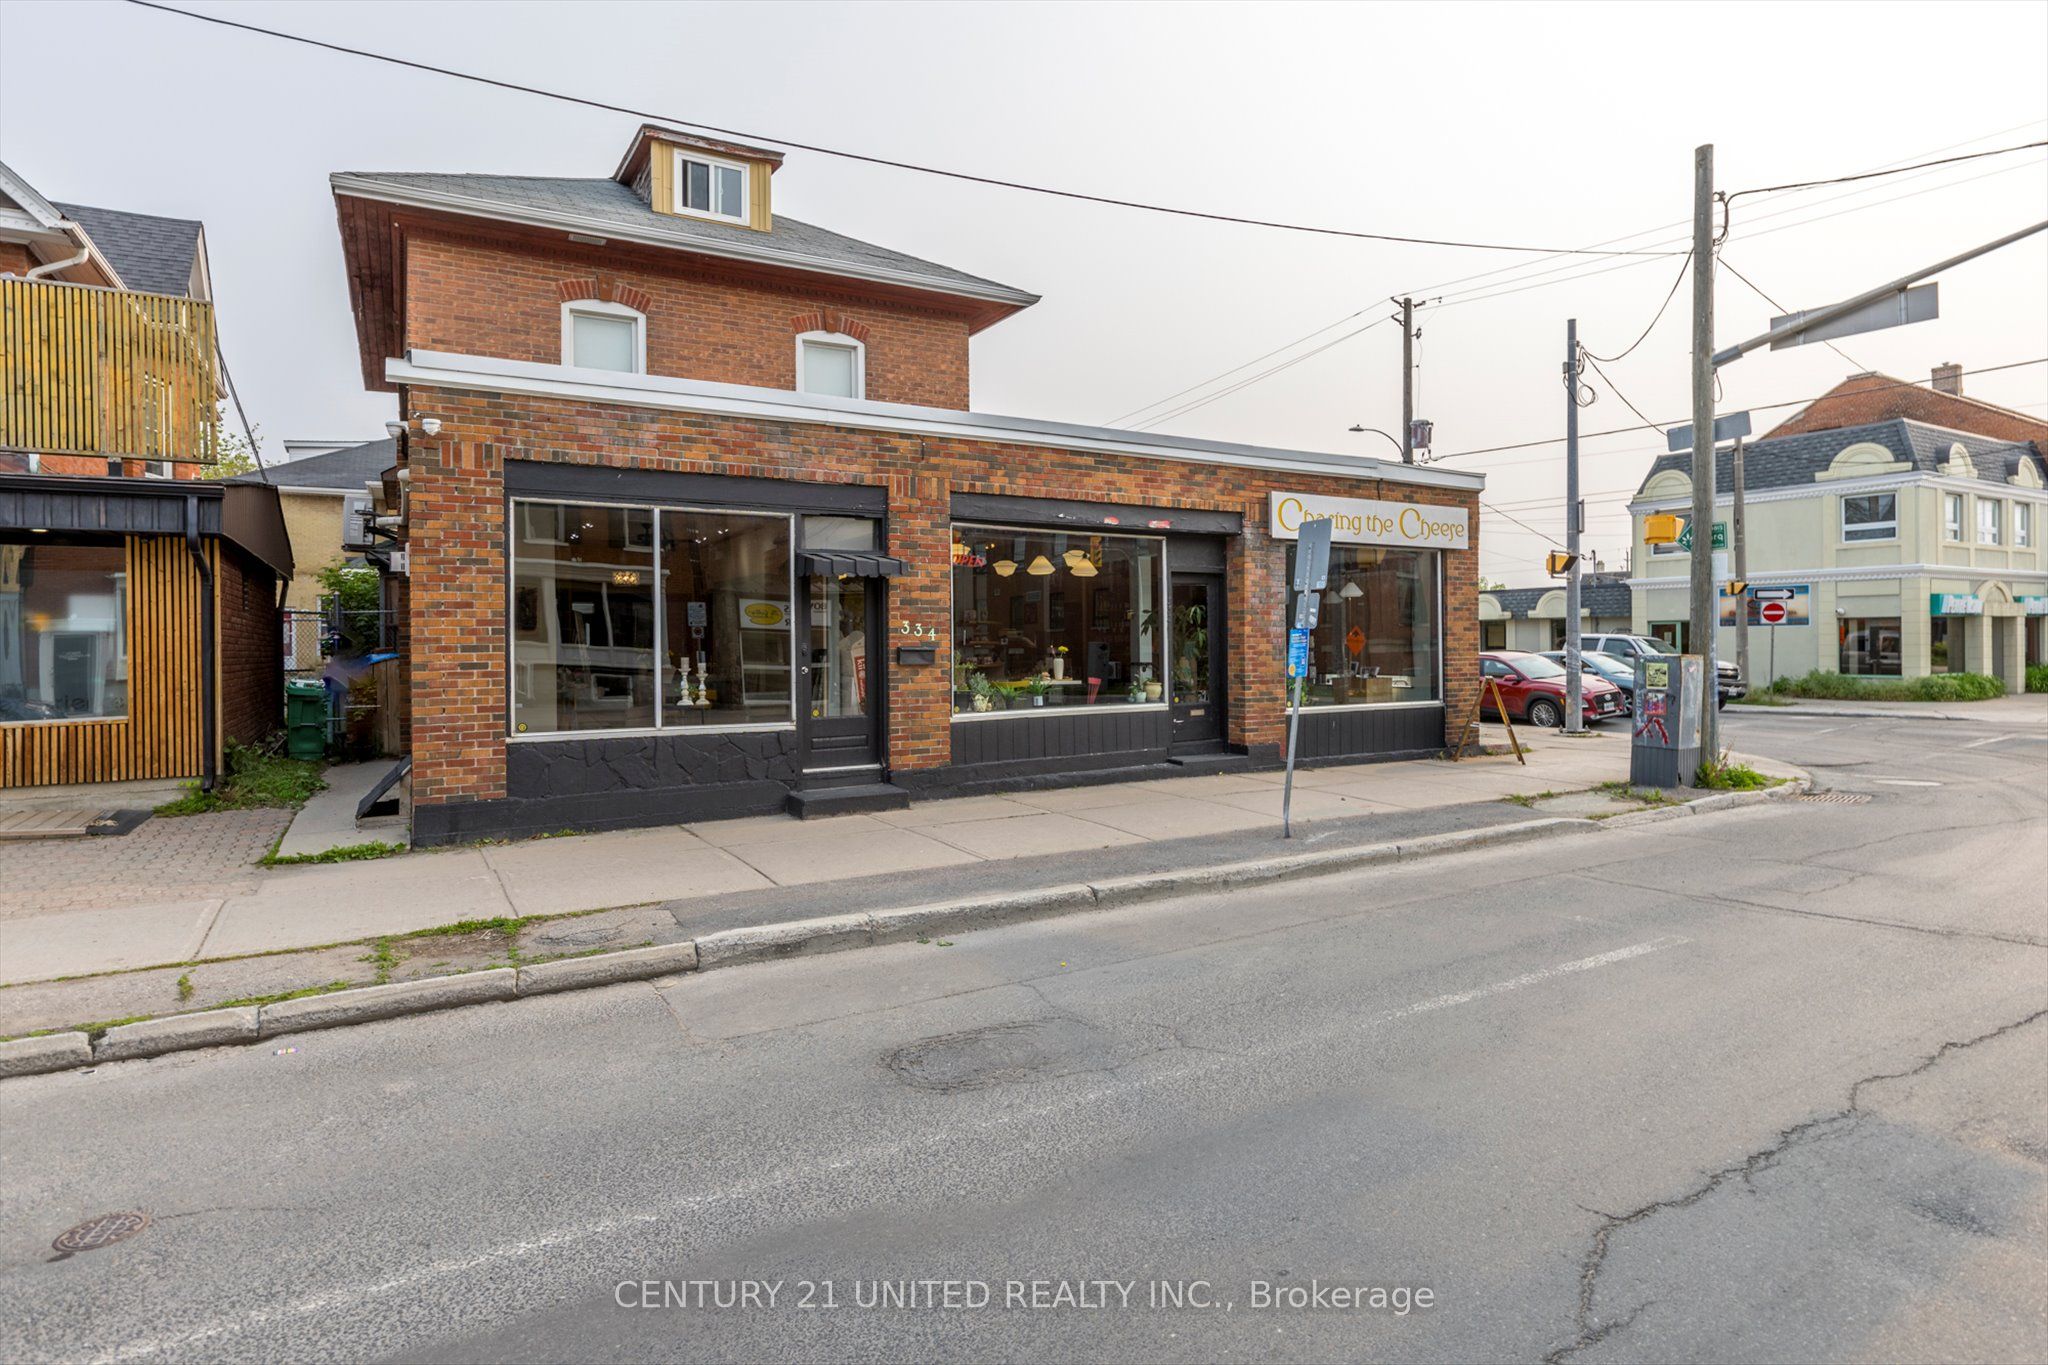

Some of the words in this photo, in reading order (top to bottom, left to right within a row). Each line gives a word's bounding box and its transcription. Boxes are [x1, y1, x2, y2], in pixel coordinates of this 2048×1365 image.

[1366, 514, 1394, 537] the
[1400, 507, 1465, 541] Cheese
[901, 620, 936, 641] 334
